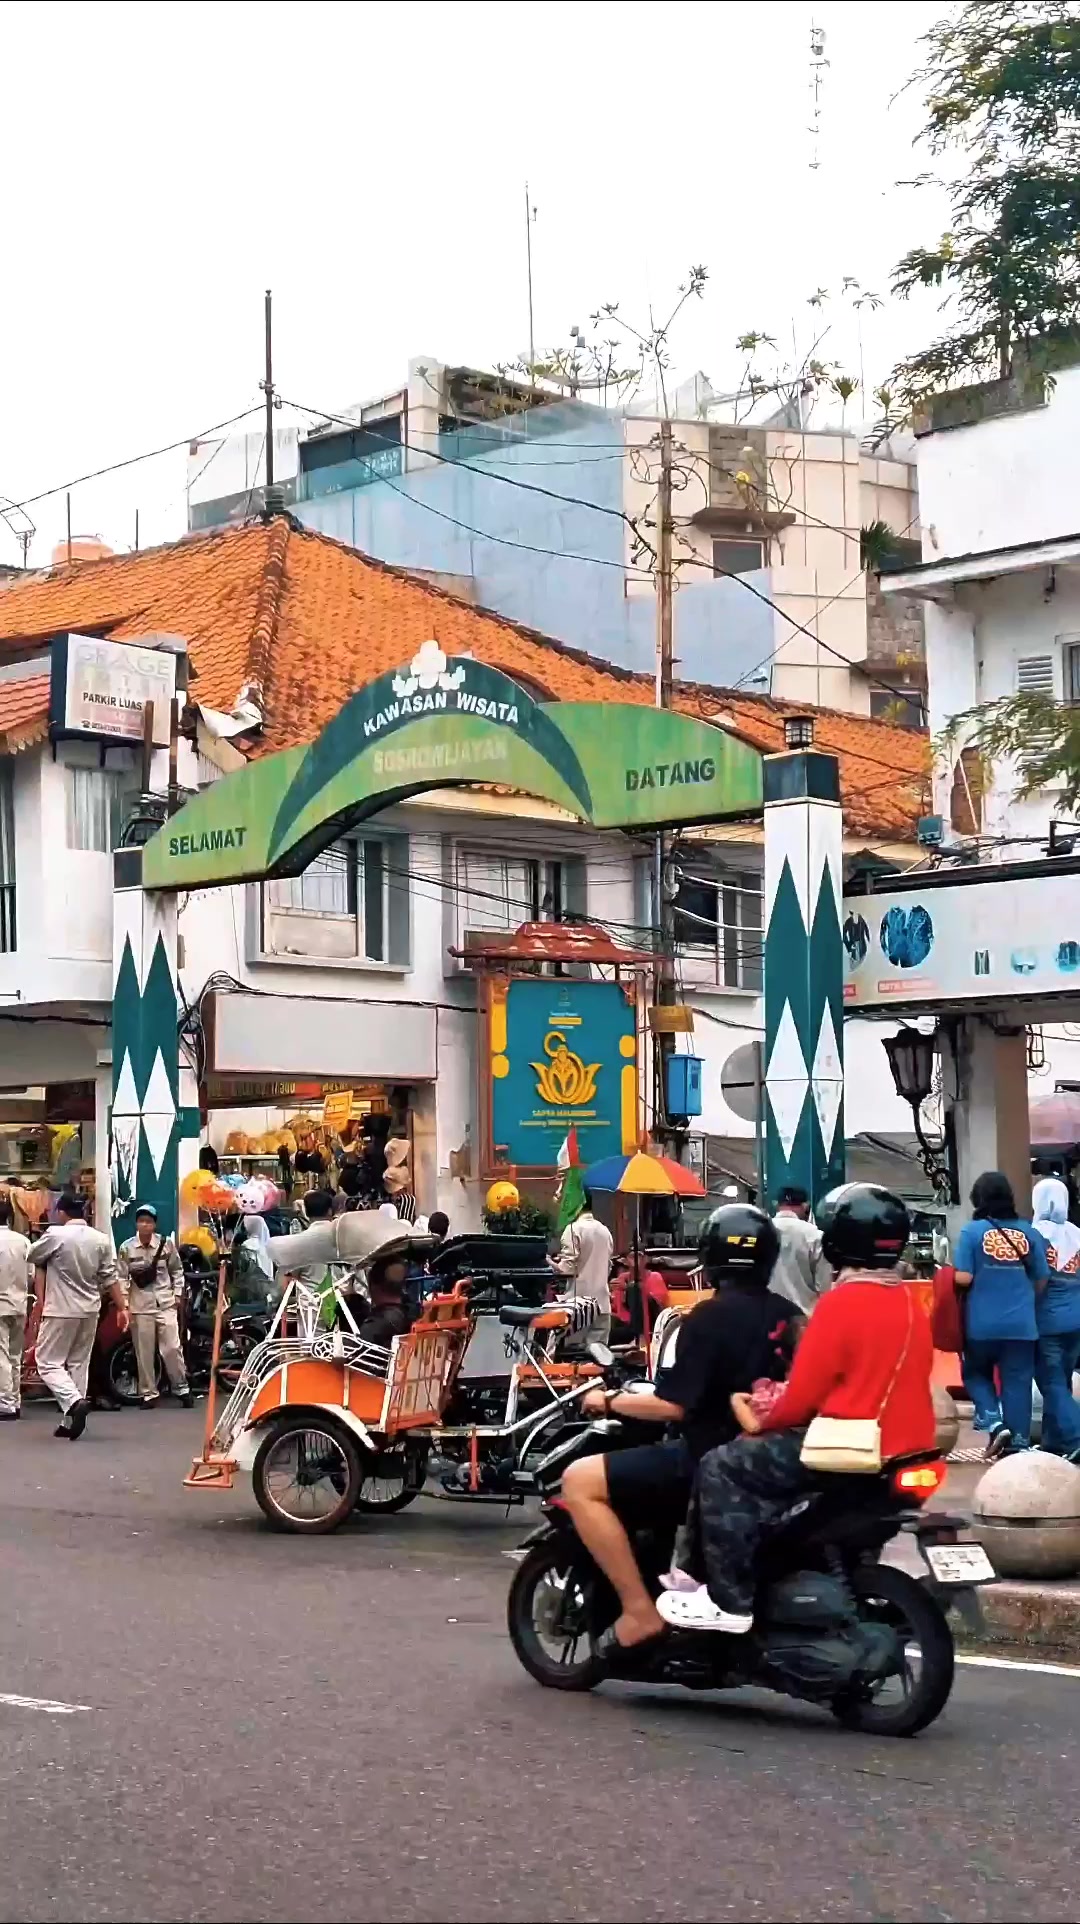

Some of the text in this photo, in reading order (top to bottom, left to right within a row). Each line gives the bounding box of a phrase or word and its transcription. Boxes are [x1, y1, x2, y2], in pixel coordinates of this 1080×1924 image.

[83, 692, 142, 712] PARKIR LUAS
[363, 691, 519, 737] KAWASAN WISATA
[626, 758, 716, 791] DATANG
[169, 826, 247, 856] SELAMAT
